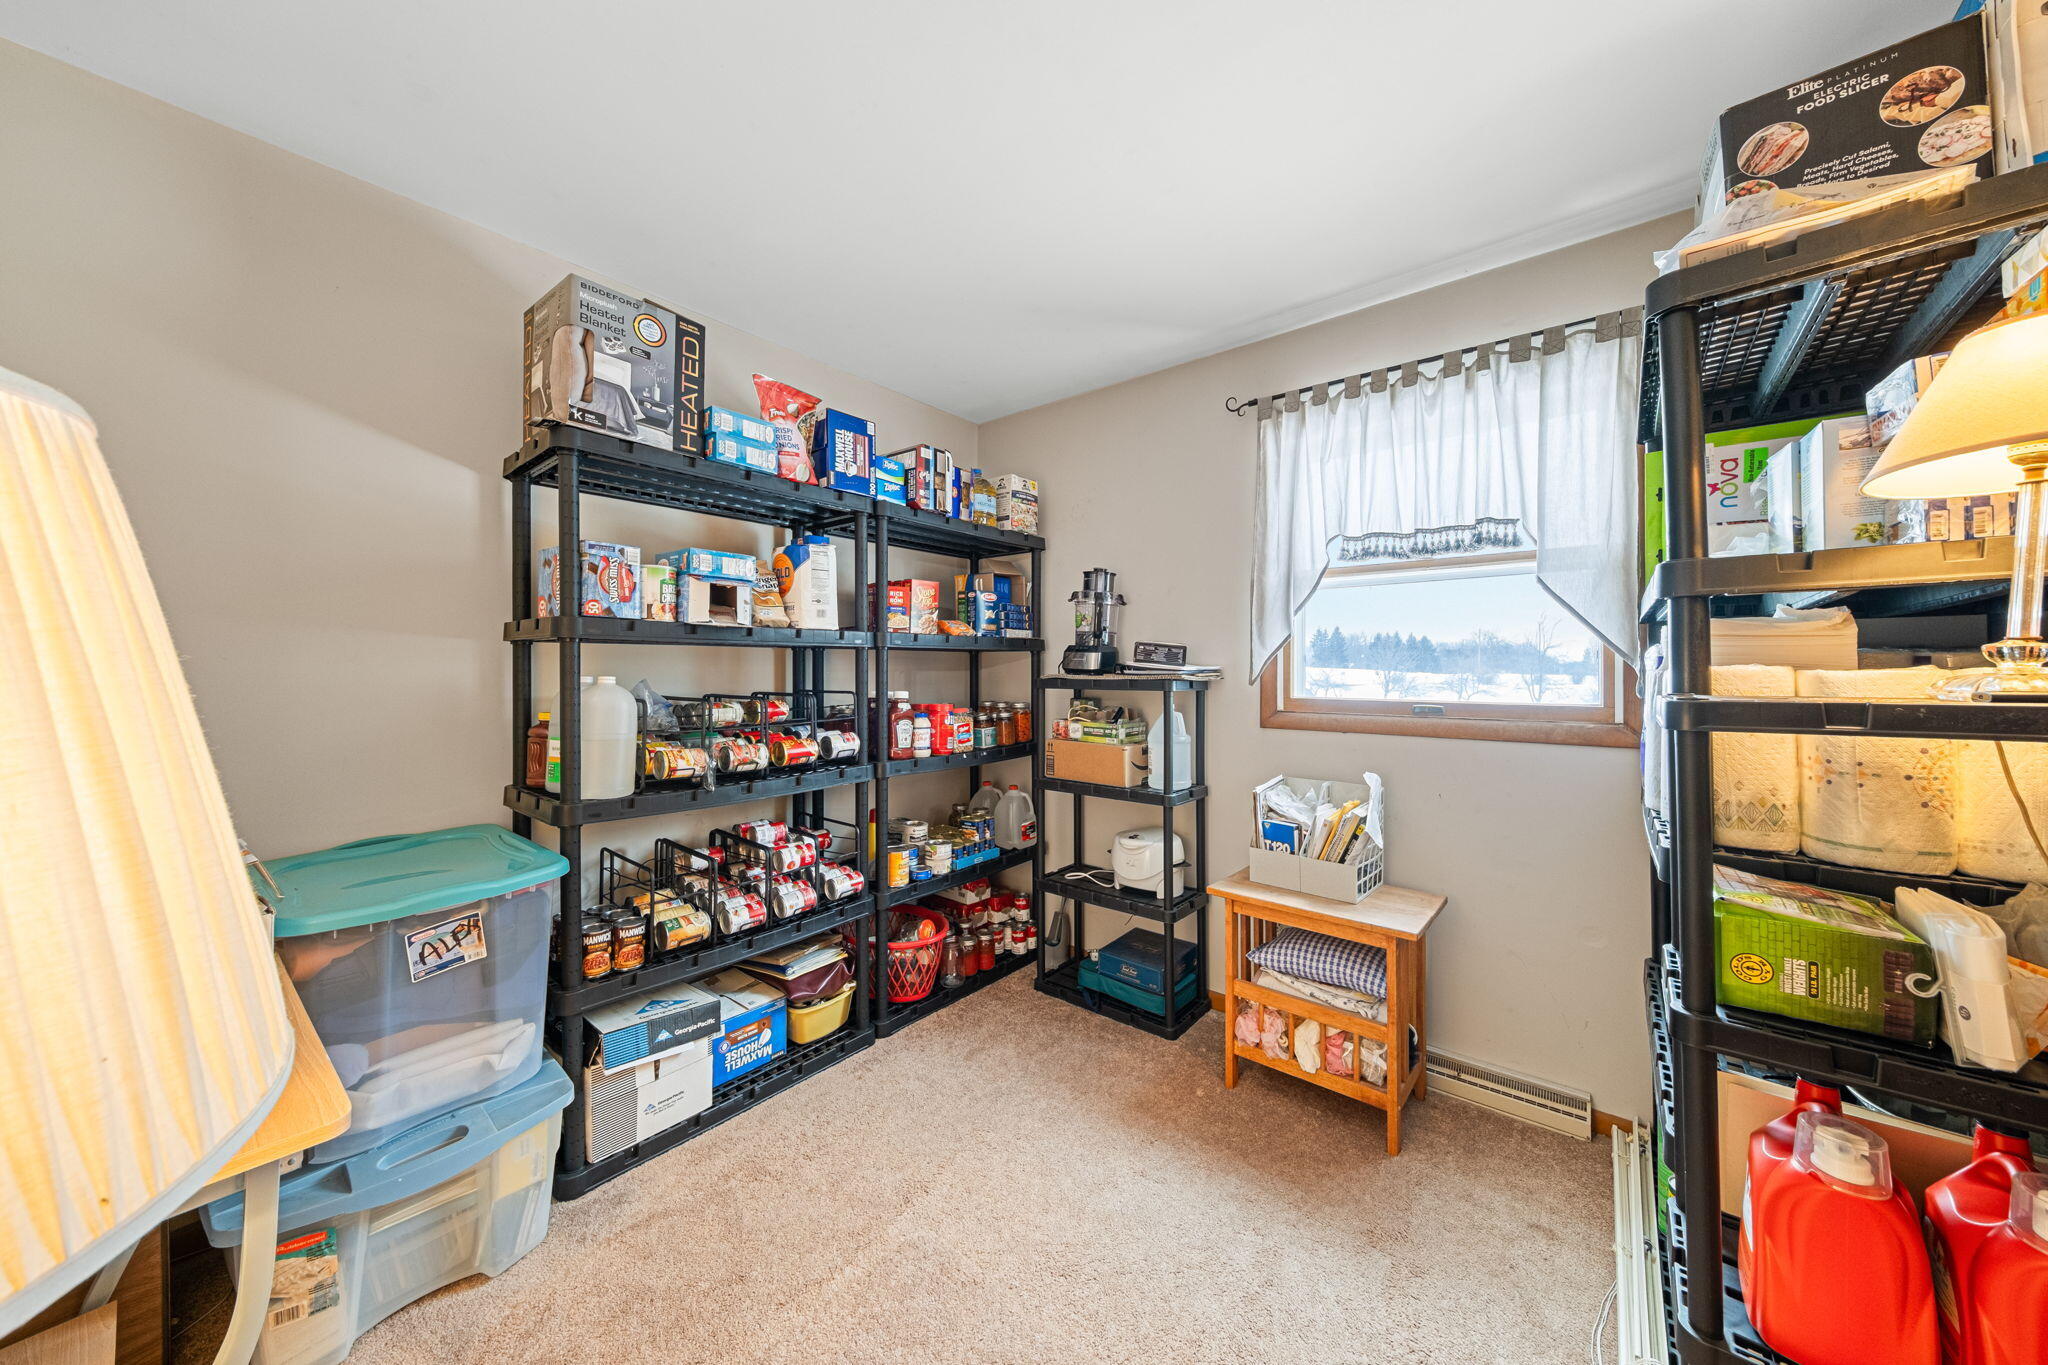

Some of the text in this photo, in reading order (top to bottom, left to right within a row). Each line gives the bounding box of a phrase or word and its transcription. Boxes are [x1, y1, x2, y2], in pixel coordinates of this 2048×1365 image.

[1786, 52, 1899, 100] Elite PLATINUM
[1813, 73, 1871, 100] ELECTRIC
[1796, 73, 1890, 115] FOOD SLICER
[1802, 148, 1894, 182] Meats, Hard Cheeses,
[1804, 141, 1892, 175] Precisely Cut Salami,
[1828, 168, 1848, 180] Firm
[1849, 153, 1900, 173] Vegetables,
[1857, 160, 1891, 177] Desired
[580, 281, 640, 310] BIDDEFORD
[579, 299, 625, 325] Heated
[579, 312, 627, 338] Blanket
[680, 336, 700, 452] HEATED
[834, 428, 846, 473] MAXWELL
[844, 430, 854, 462] HOUSE
[883, 482, 901, 492] Ziploc
[1720, 457, 1739, 508] nova
[608, 579, 620, 604] SWISS
[588, 601, 599, 614] 50
[1792, 959, 1806, 996] WEIGHTS
[1810, 965, 1818, 979] PAIR
[674, 1018, 716, 1036] Georgia-Pacific
[724, 1039, 761, 1064] HOUSE
[724, 1043, 773, 1073] MAXWELL
